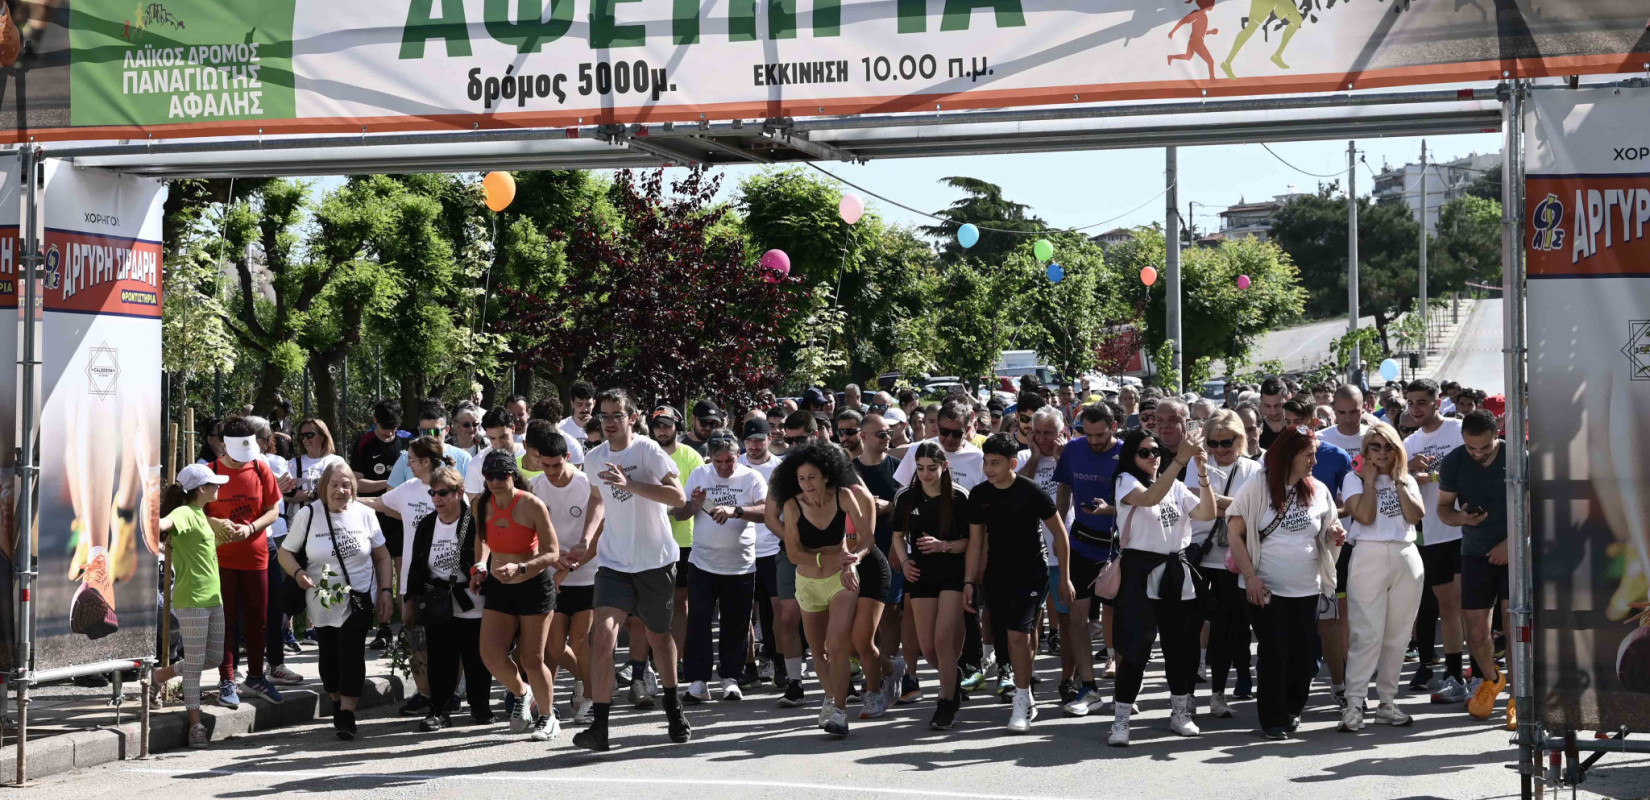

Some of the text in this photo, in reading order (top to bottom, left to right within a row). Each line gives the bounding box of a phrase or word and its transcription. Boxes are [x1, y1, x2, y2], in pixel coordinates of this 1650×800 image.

[123, 43, 260, 69] ΛΑΪΚΟΣ ΔΡΟΜΟΣ
[753, 54, 994, 87] ΕΚΚΙΝΗΣΗ 10.00 π.μ.
[122, 65, 262, 94] ΠΑΝΑΓΙΩΤΗΣ
[467, 64, 568, 109] δρόμος
[168, 91, 264, 119] ΑΦΑΛΗΣ
[63, 242, 114, 301] ΑΡΓΥΡΗ
[116, 247, 157, 288] ΣΙΡΔΑΡΗ
